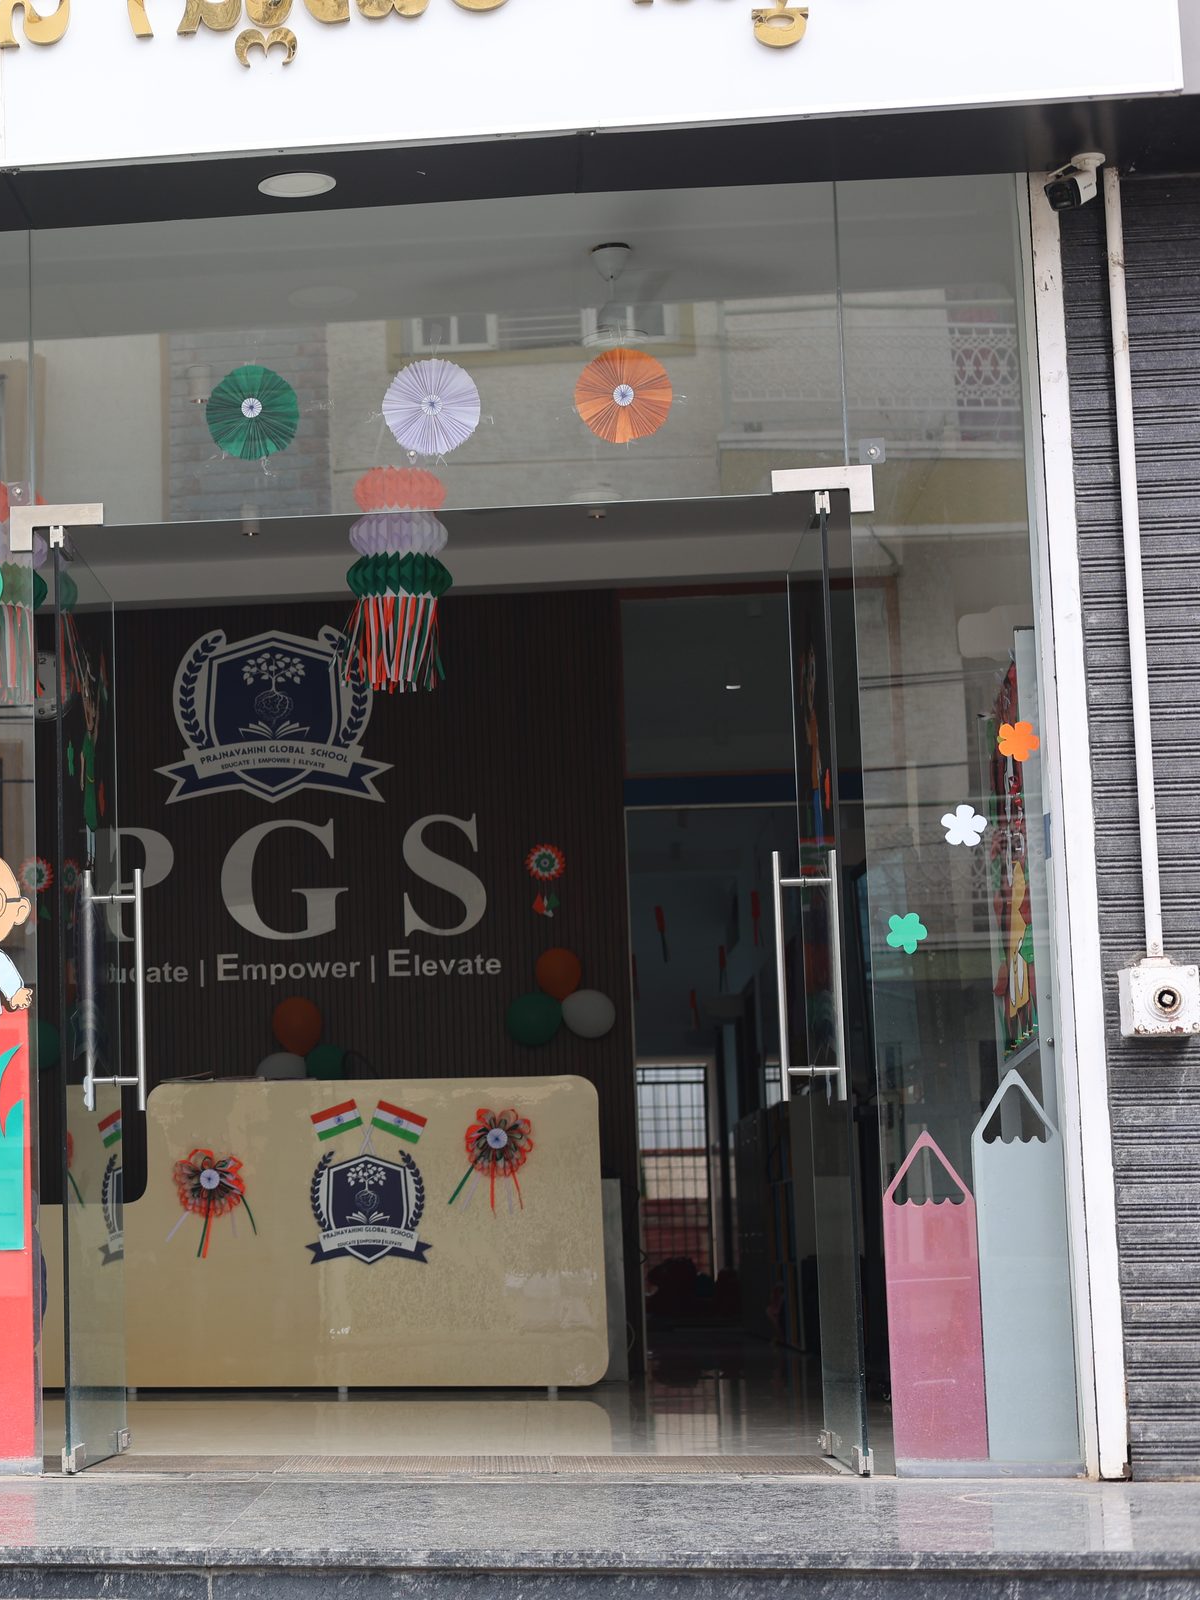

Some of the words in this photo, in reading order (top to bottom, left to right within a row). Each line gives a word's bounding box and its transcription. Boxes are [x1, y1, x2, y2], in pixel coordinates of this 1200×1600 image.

[200, 745, 266, 765] PRAJNAVAHINI
[269, 745, 305, 755] GLOBAL
[311, 748, 348, 763] SCHOOL
[221, 760, 250, 770] EDUCATE
[298, 759, 326, 769] ELEVATE
[216, 953, 360, 985] Empower
[387, 948, 502, 977] Elevate
[390, 1229, 415, 1240] SCHOOL
